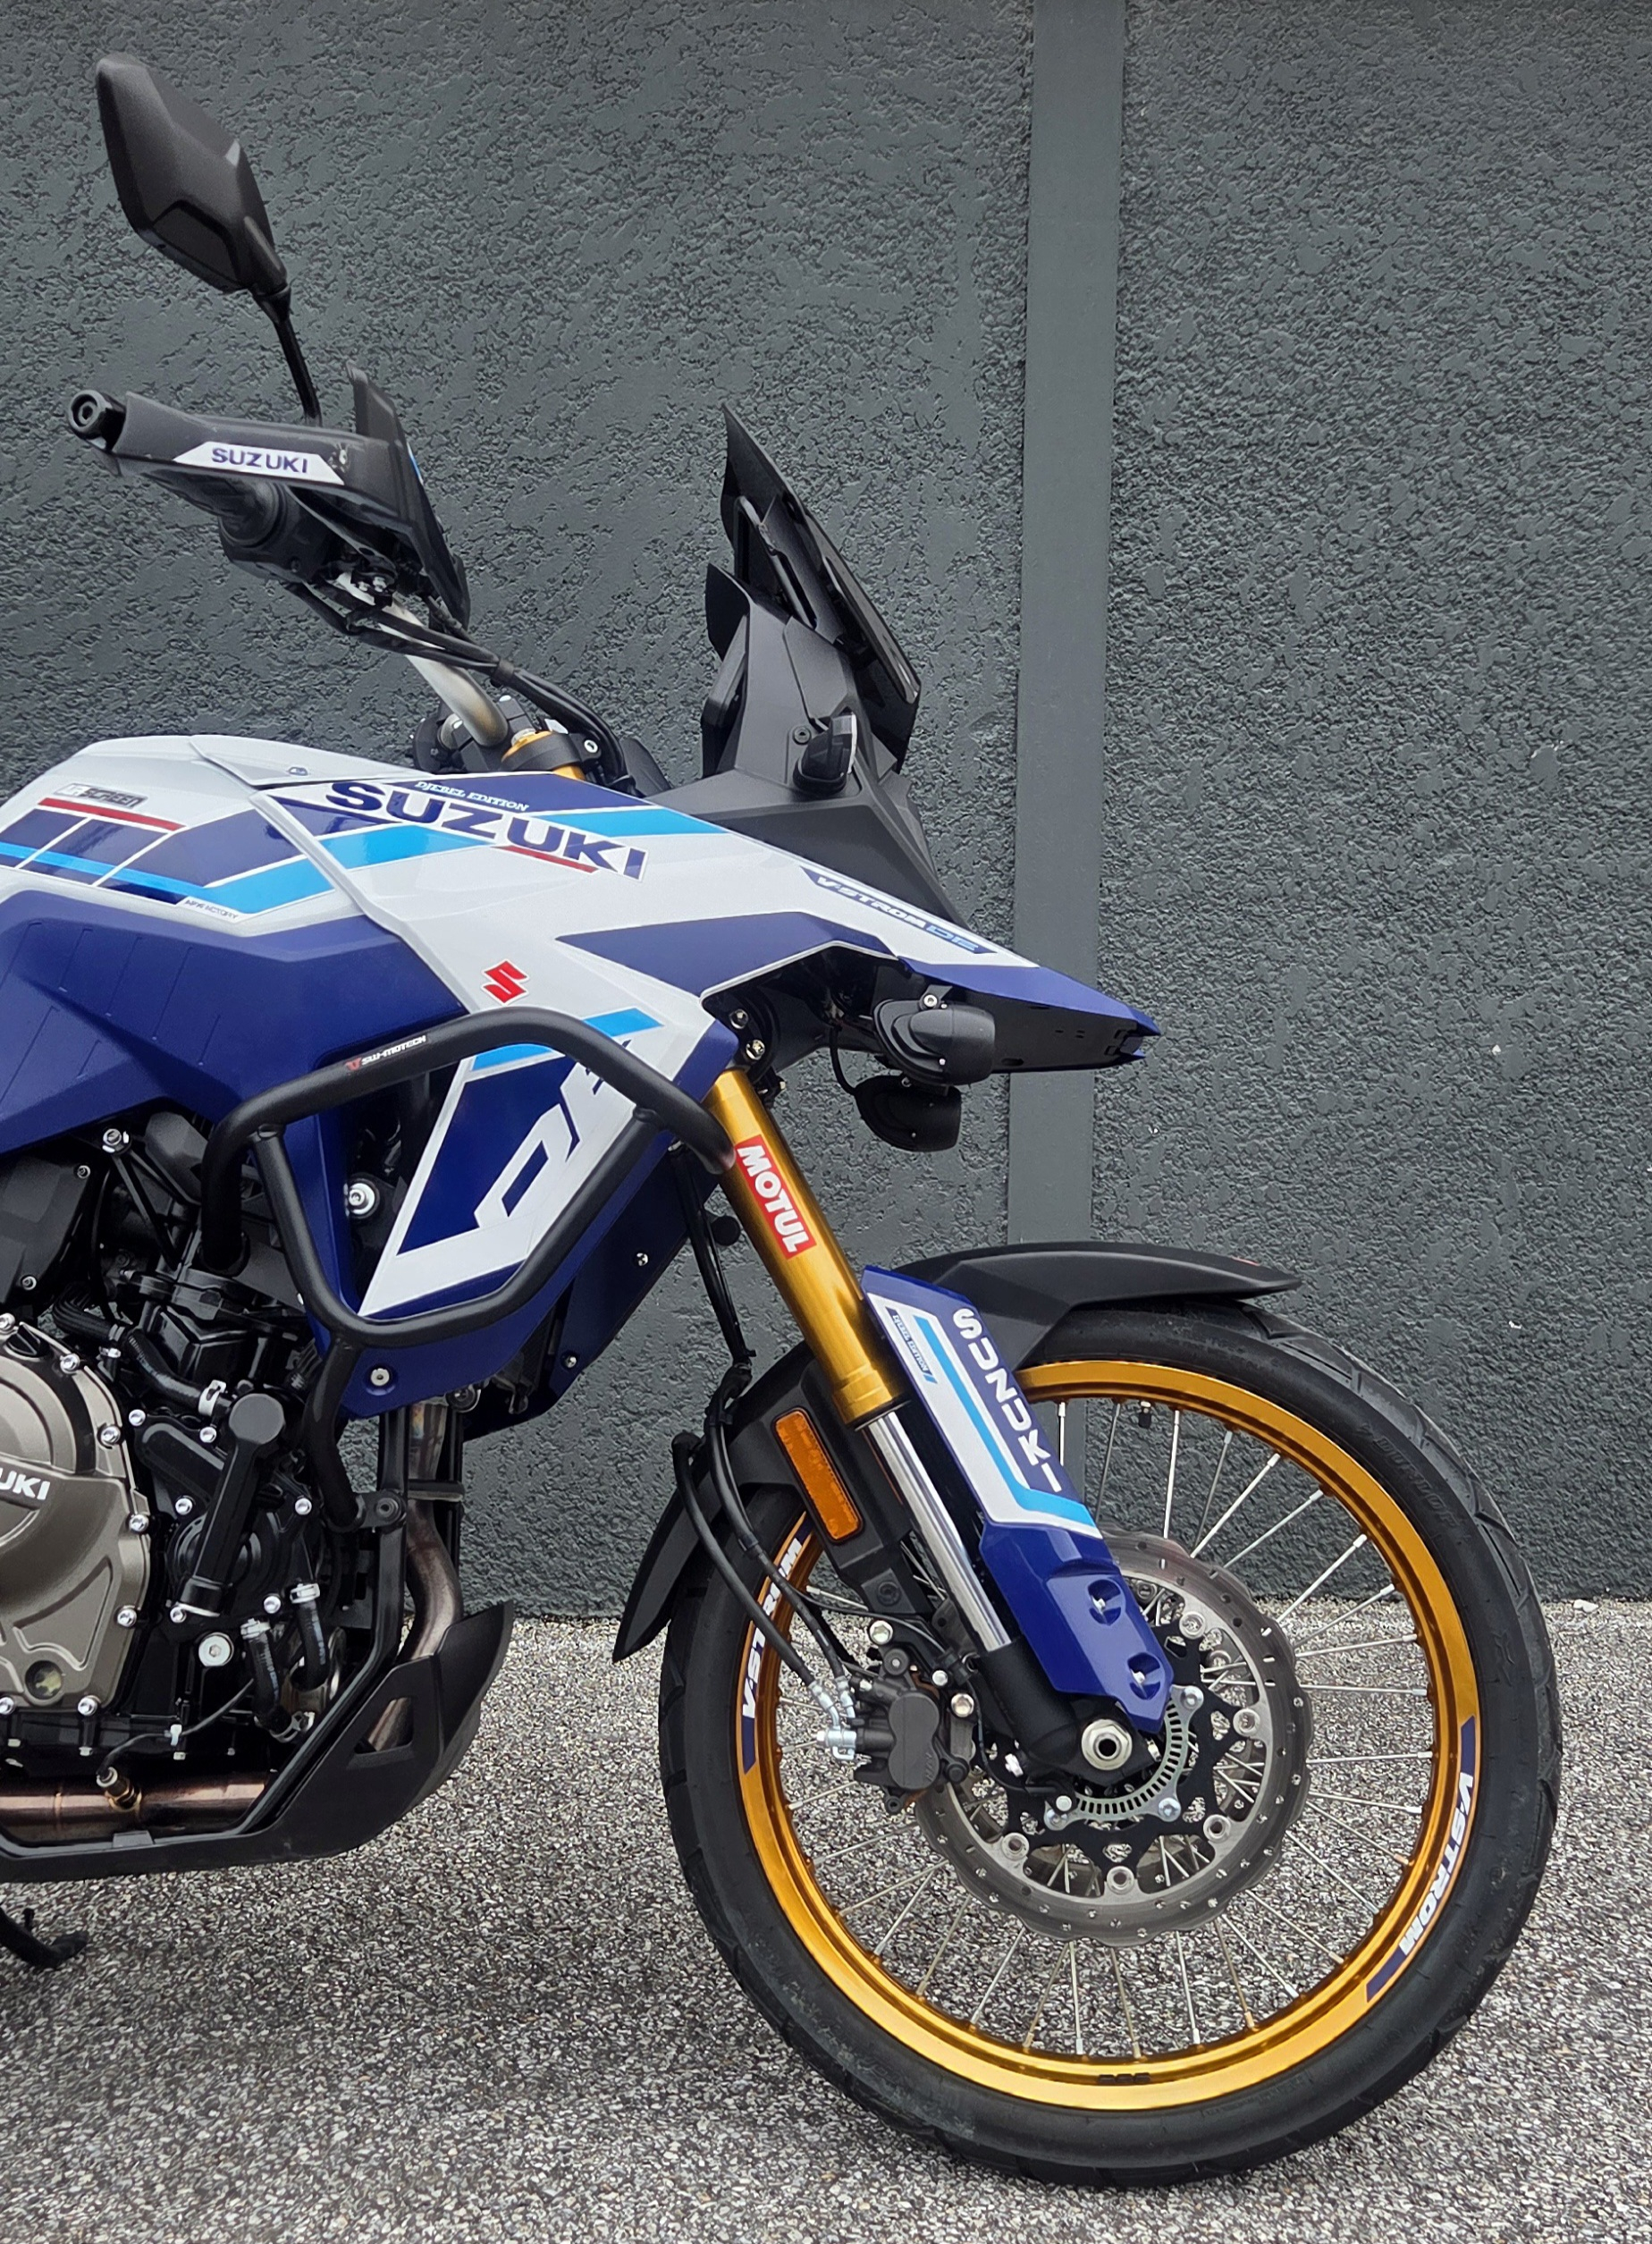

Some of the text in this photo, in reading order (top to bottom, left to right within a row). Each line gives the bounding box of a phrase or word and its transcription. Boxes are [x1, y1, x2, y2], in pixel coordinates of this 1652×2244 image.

[211, 448, 308, 474] SUZUKI
[325, 781, 646, 881] SUZUKI
[415, 781, 530, 812] DJEBEL EDITION
[361, 1035, 426, 1066] SW-MOTECH
[737, 1145, 810, 1253] MOTUL
[953, 1308, 1062, 1492] SUZUKI
[1398, 1772, 1474, 1956] V-STROM
